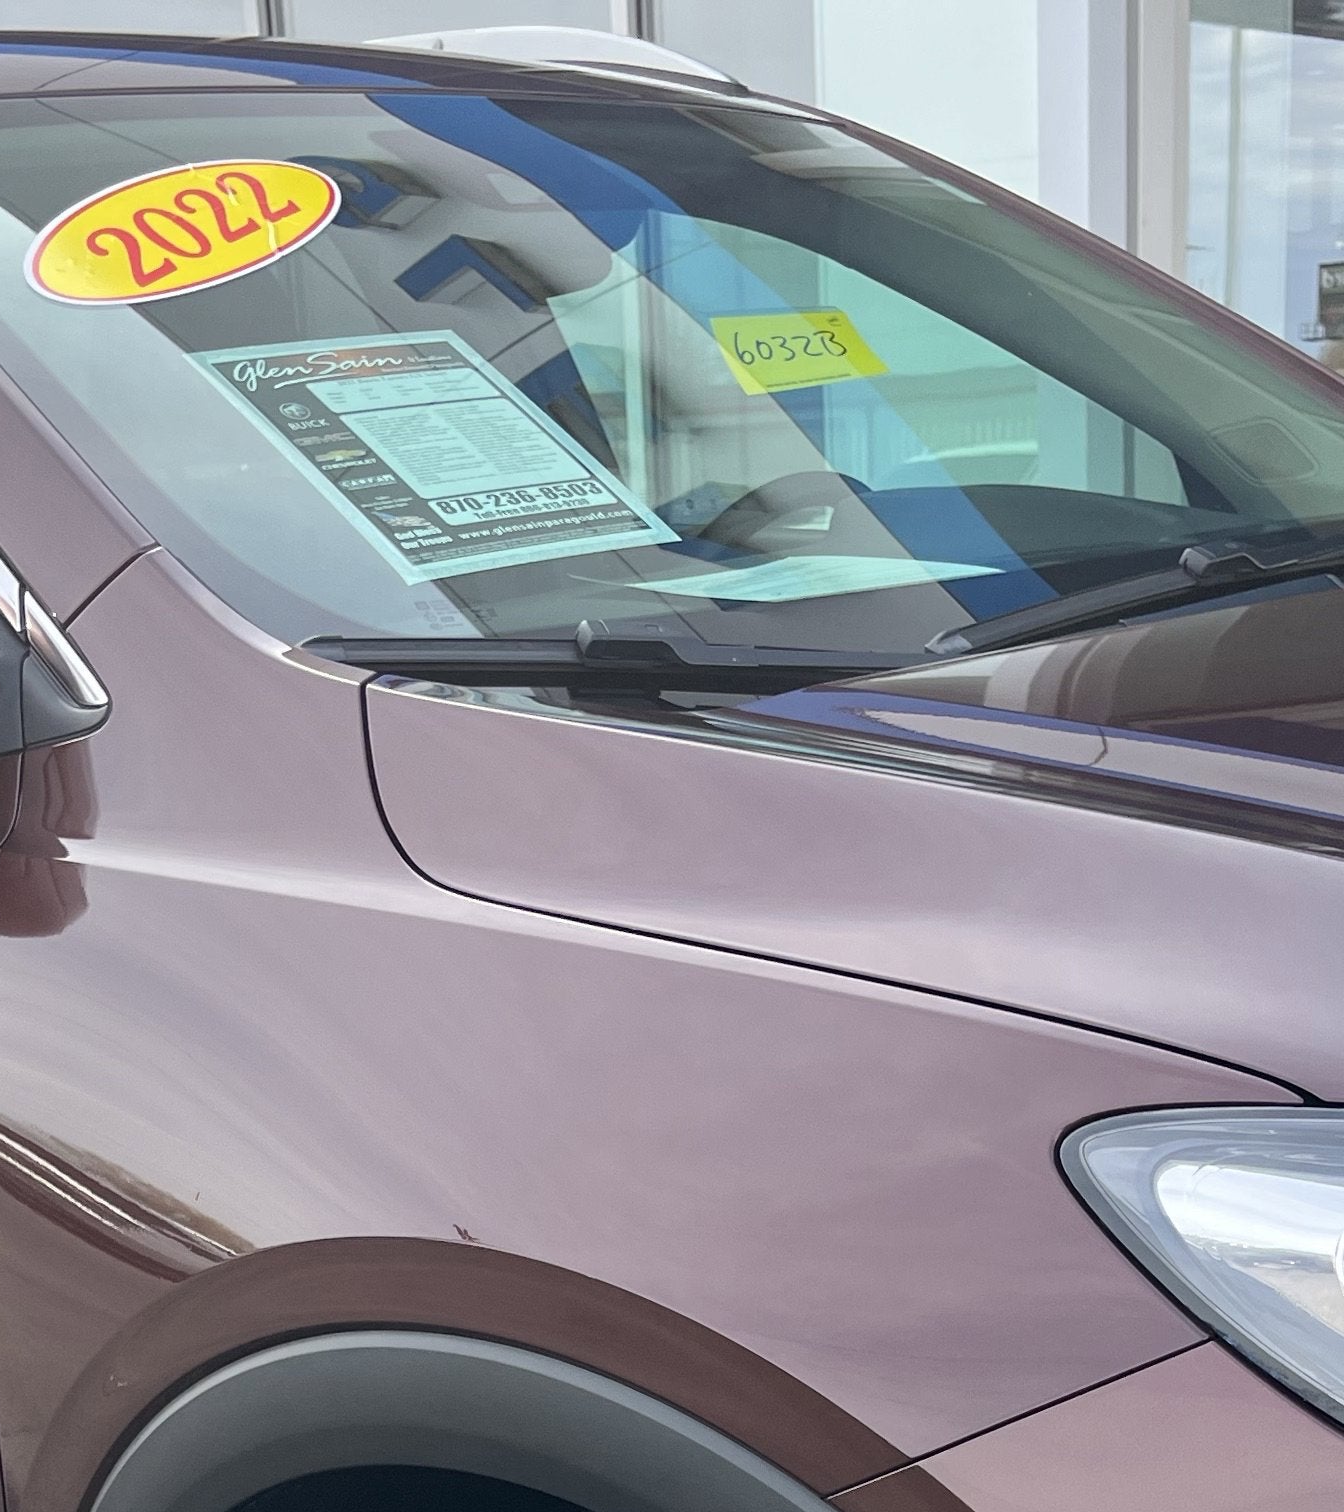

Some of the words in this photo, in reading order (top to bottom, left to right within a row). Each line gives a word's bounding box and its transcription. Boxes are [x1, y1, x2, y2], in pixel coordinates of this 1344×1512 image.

[86, 171, 301, 287] 2022
[233, 358, 312, 391] Glen
[307, 352, 402, 376] Sain
[287, 418, 330, 431] BUICK
[436, 481, 604, 515] 870-236-8503
[458, 509, 634, 540] www.glensainparagould.com
